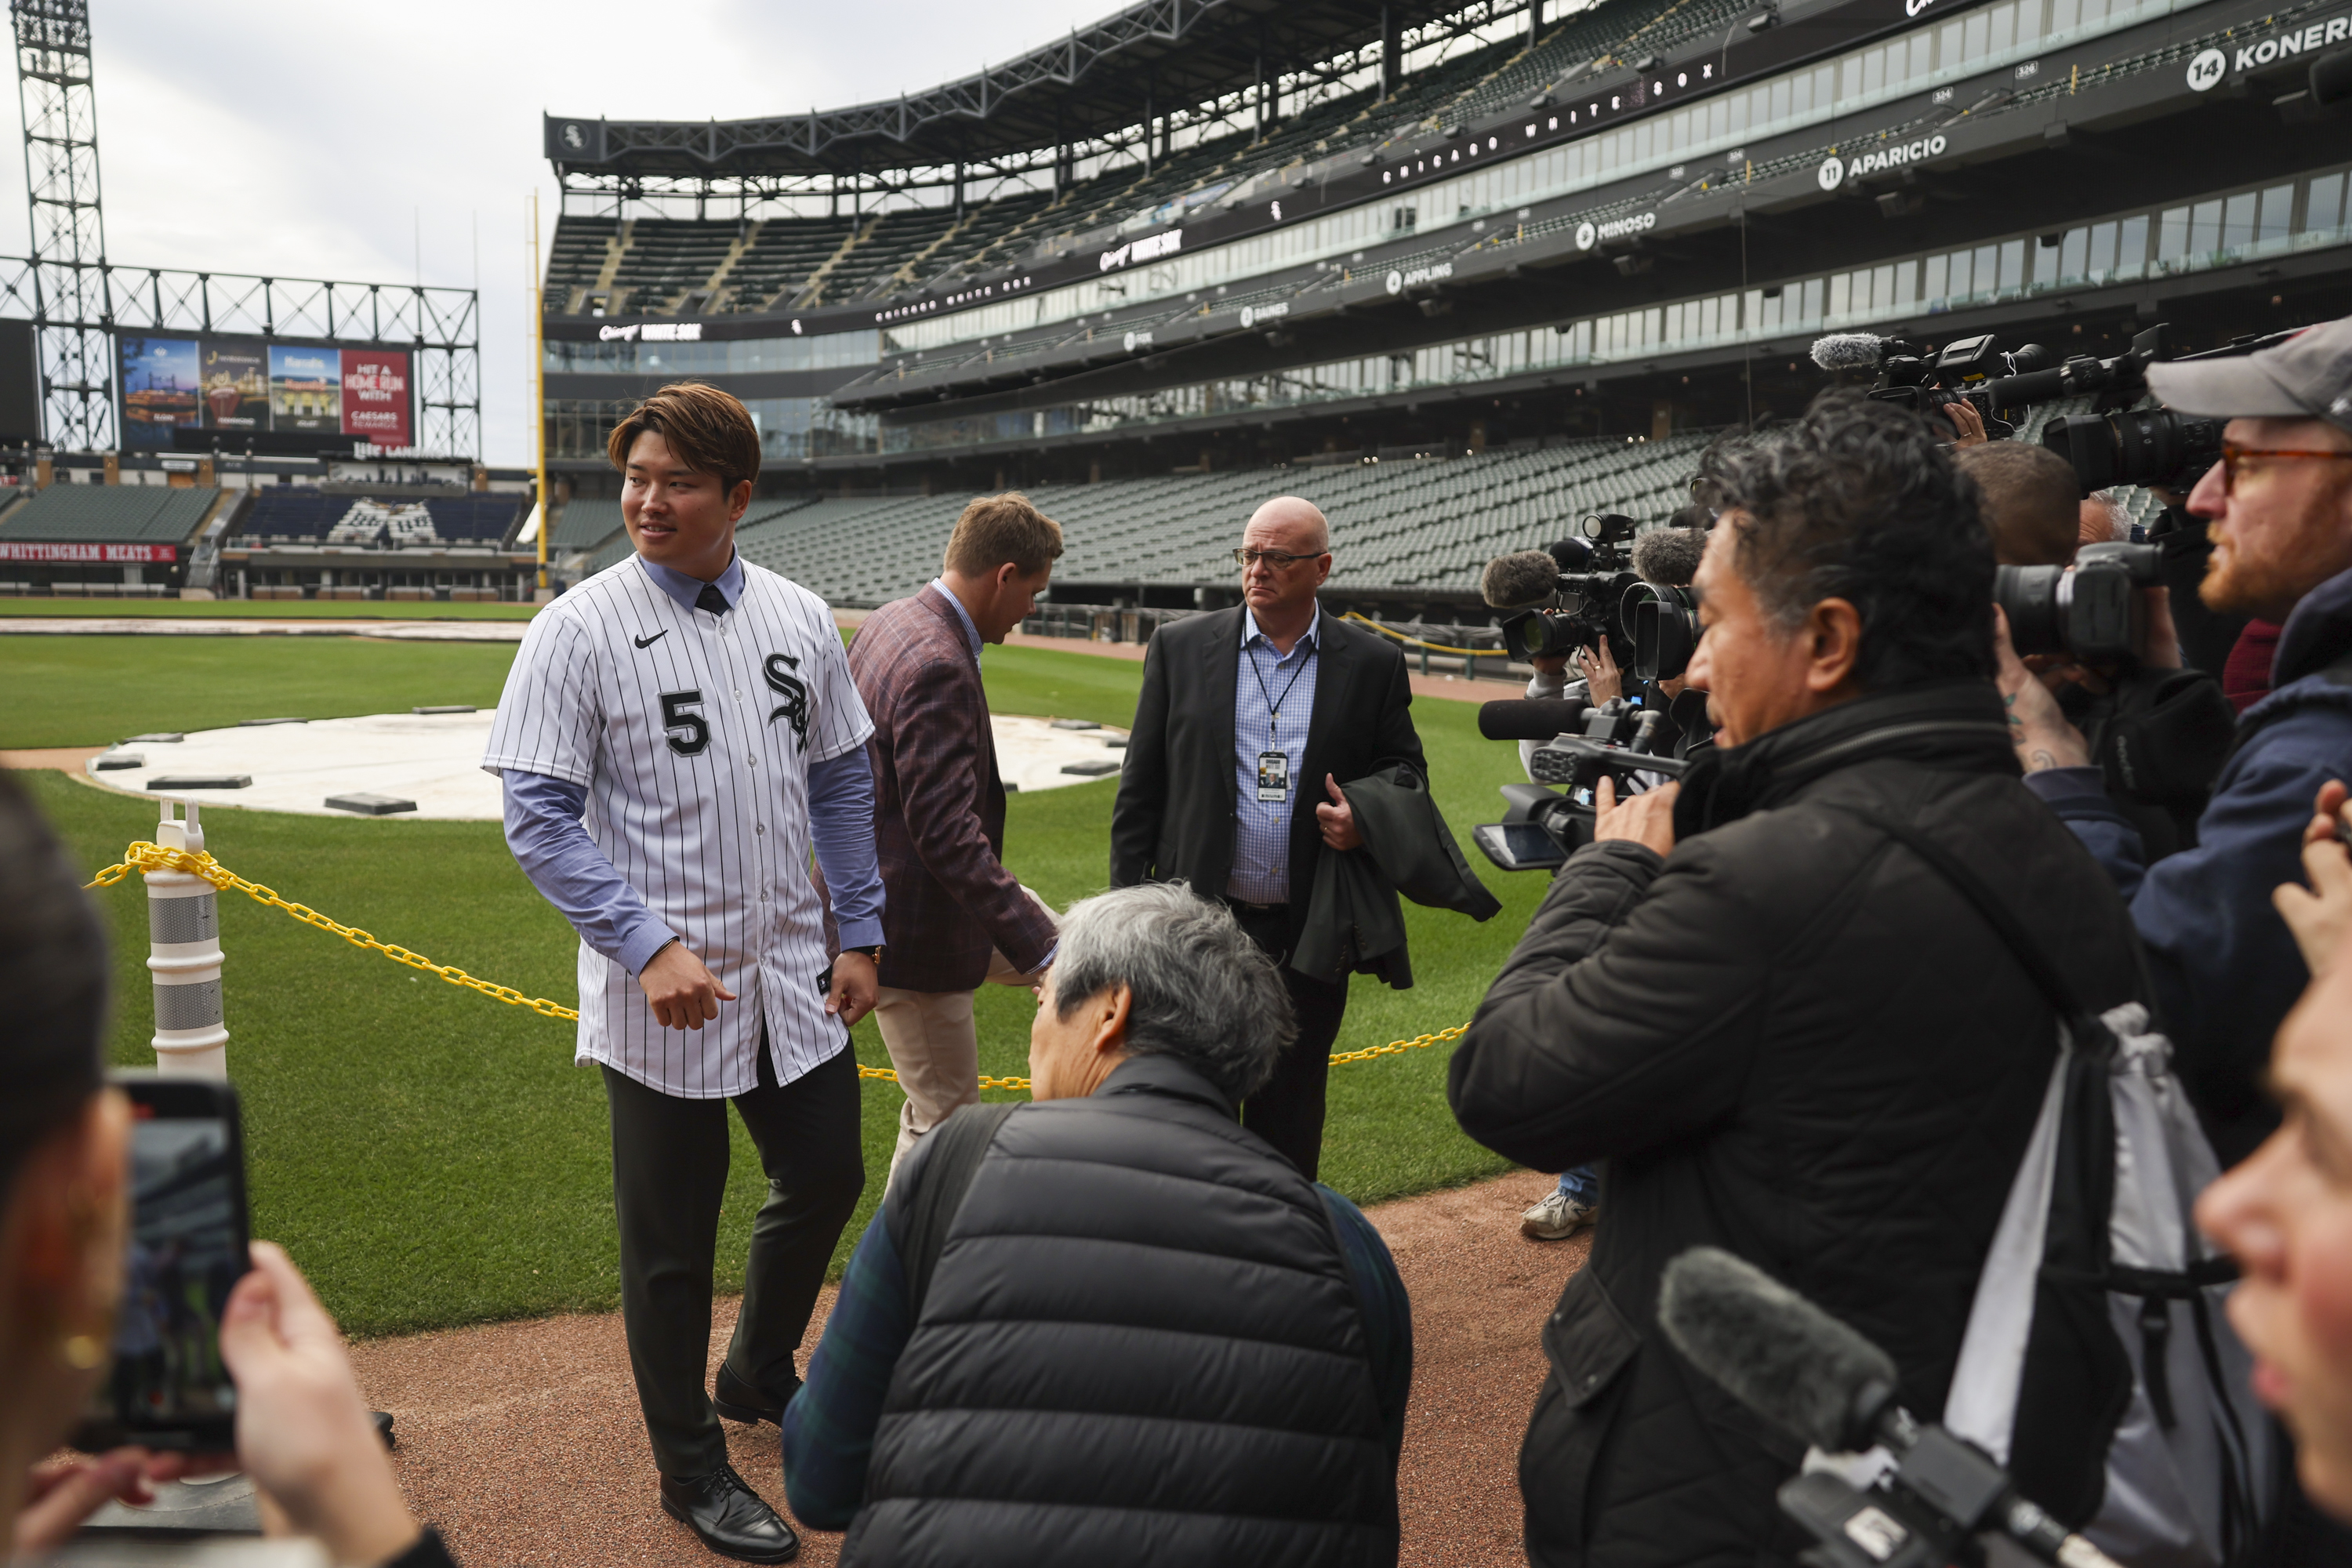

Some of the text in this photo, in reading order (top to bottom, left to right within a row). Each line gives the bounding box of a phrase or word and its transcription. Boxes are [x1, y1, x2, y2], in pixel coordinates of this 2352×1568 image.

[2194, 13, 2352, 81] 14 KONER
[2018, 63, 2036, 75] 326
[1935, 89, 1953, 100] 324
[1382, 63, 1713, 184] CHICAGO WHITE SOX
[1848, 135, 1947, 178] APARICIO
[1403, 262, 1453, 286] APPLING
[1254, 302, 1290, 321] BAINES
[357, 364, 392, 376] HIT A
[344, 373, 405, 392] HOME RUN
[358, 389, 393, 402] WITH
[350, 411, 398, 421] CAESARS
[0, 543, 101, 561] WHITTINGHAM
[105, 544, 153, 561] MEATS
[657, 688, 713, 758] 5
